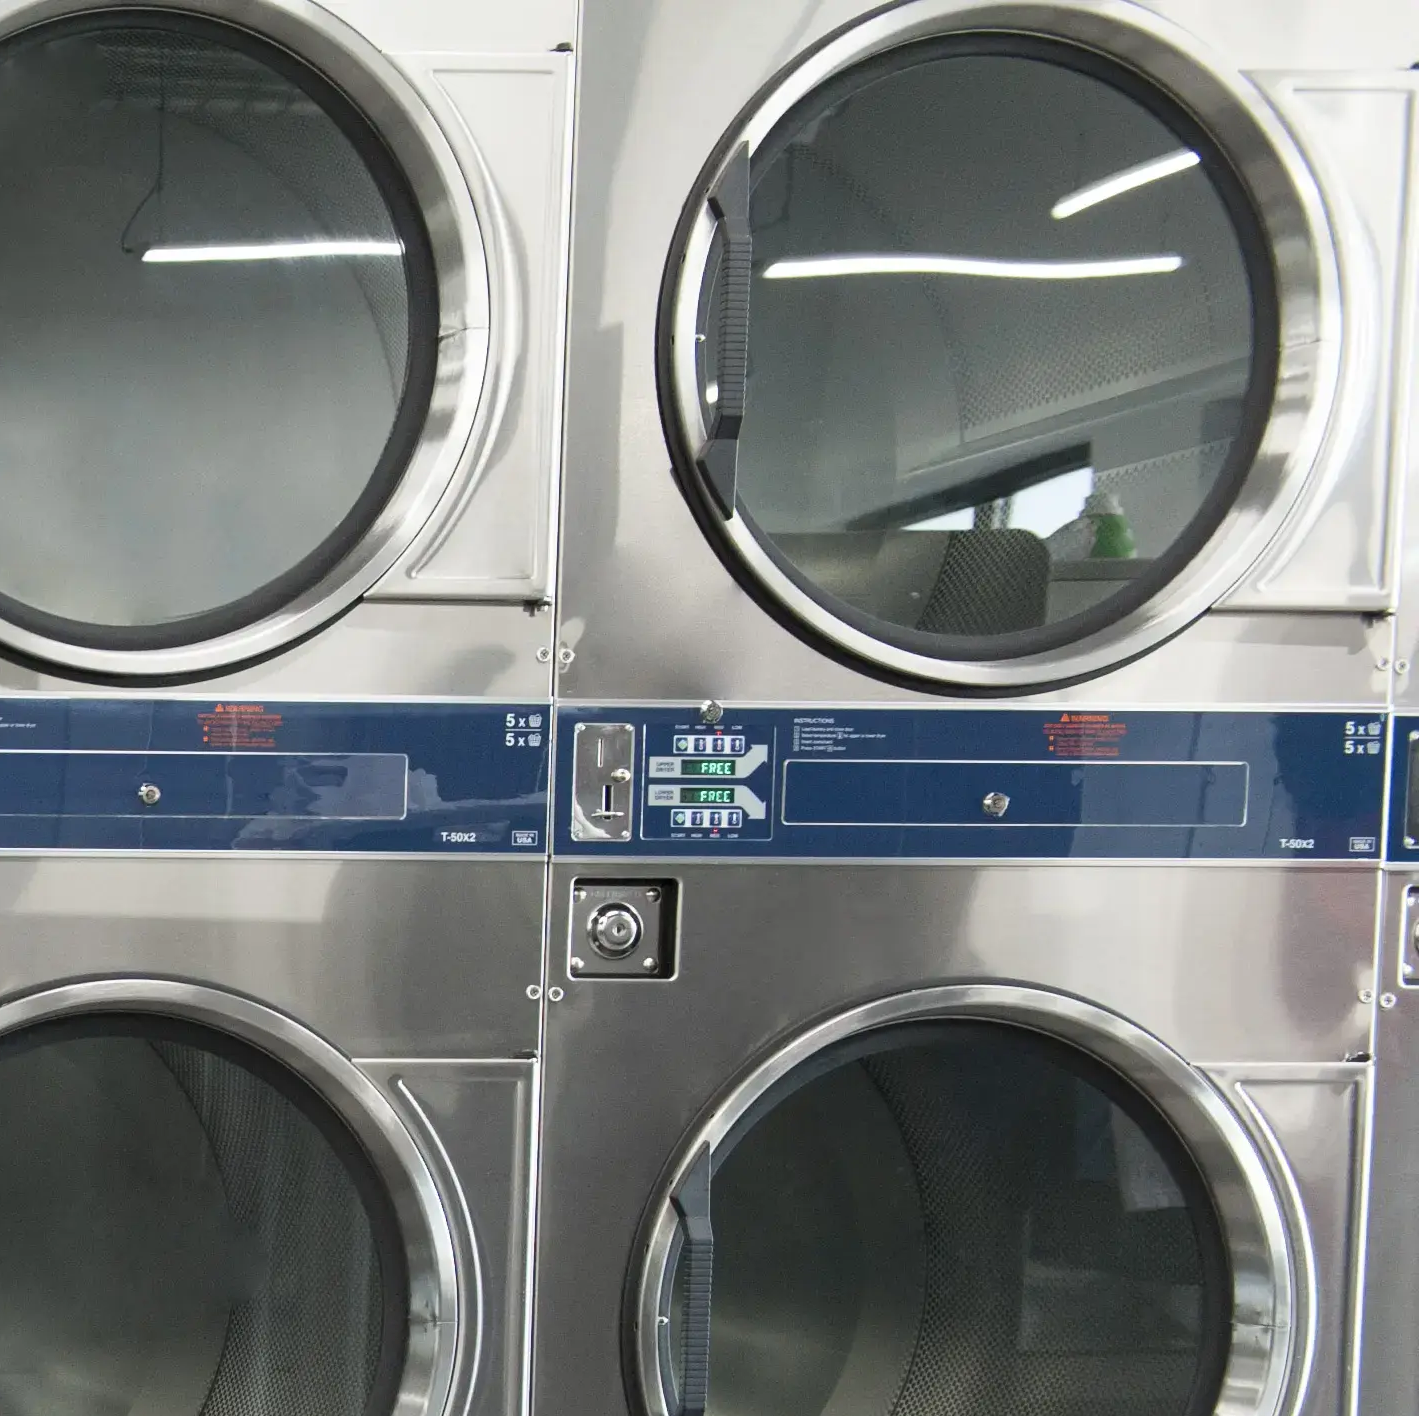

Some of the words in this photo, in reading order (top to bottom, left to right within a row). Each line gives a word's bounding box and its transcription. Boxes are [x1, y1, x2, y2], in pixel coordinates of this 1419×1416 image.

[506, 713, 516, 727] 5
[518, 718, 526, 727] x
[1345, 722, 1355, 735] 5
[505, 733, 515, 747] 5
[518, 738, 525, 747] x
[1344, 741, 1354, 754] 5
[701, 763, 732, 774] FREE
[700, 791, 731, 802] FREE
[440, 832, 476, 842] T-50X2
[1279, 839, 1314, 848] T-50X2
